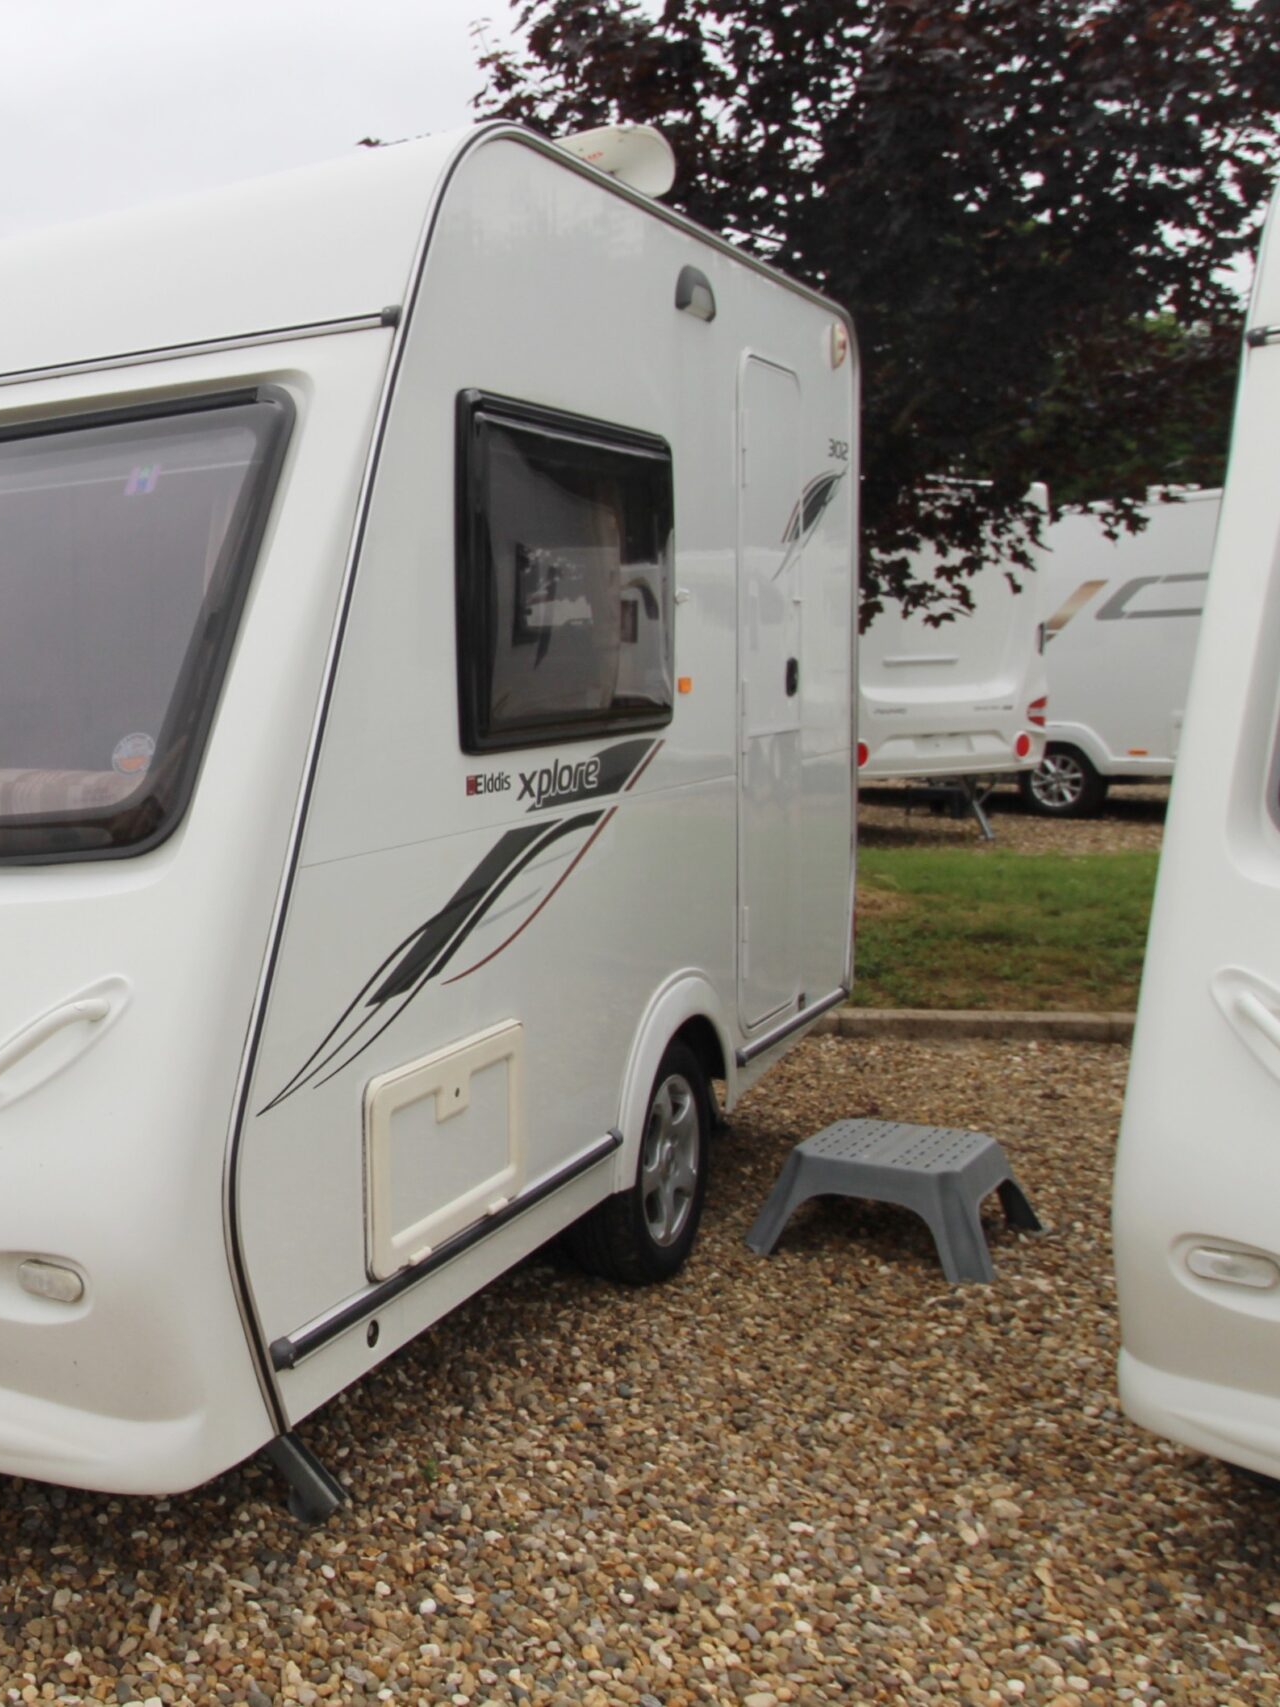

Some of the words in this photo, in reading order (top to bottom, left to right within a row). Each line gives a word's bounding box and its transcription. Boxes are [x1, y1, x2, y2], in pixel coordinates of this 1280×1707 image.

[827, 438, 849, 461] 302
[475, 771, 511, 795] Elddis
[517, 757, 601, 809] xplore
